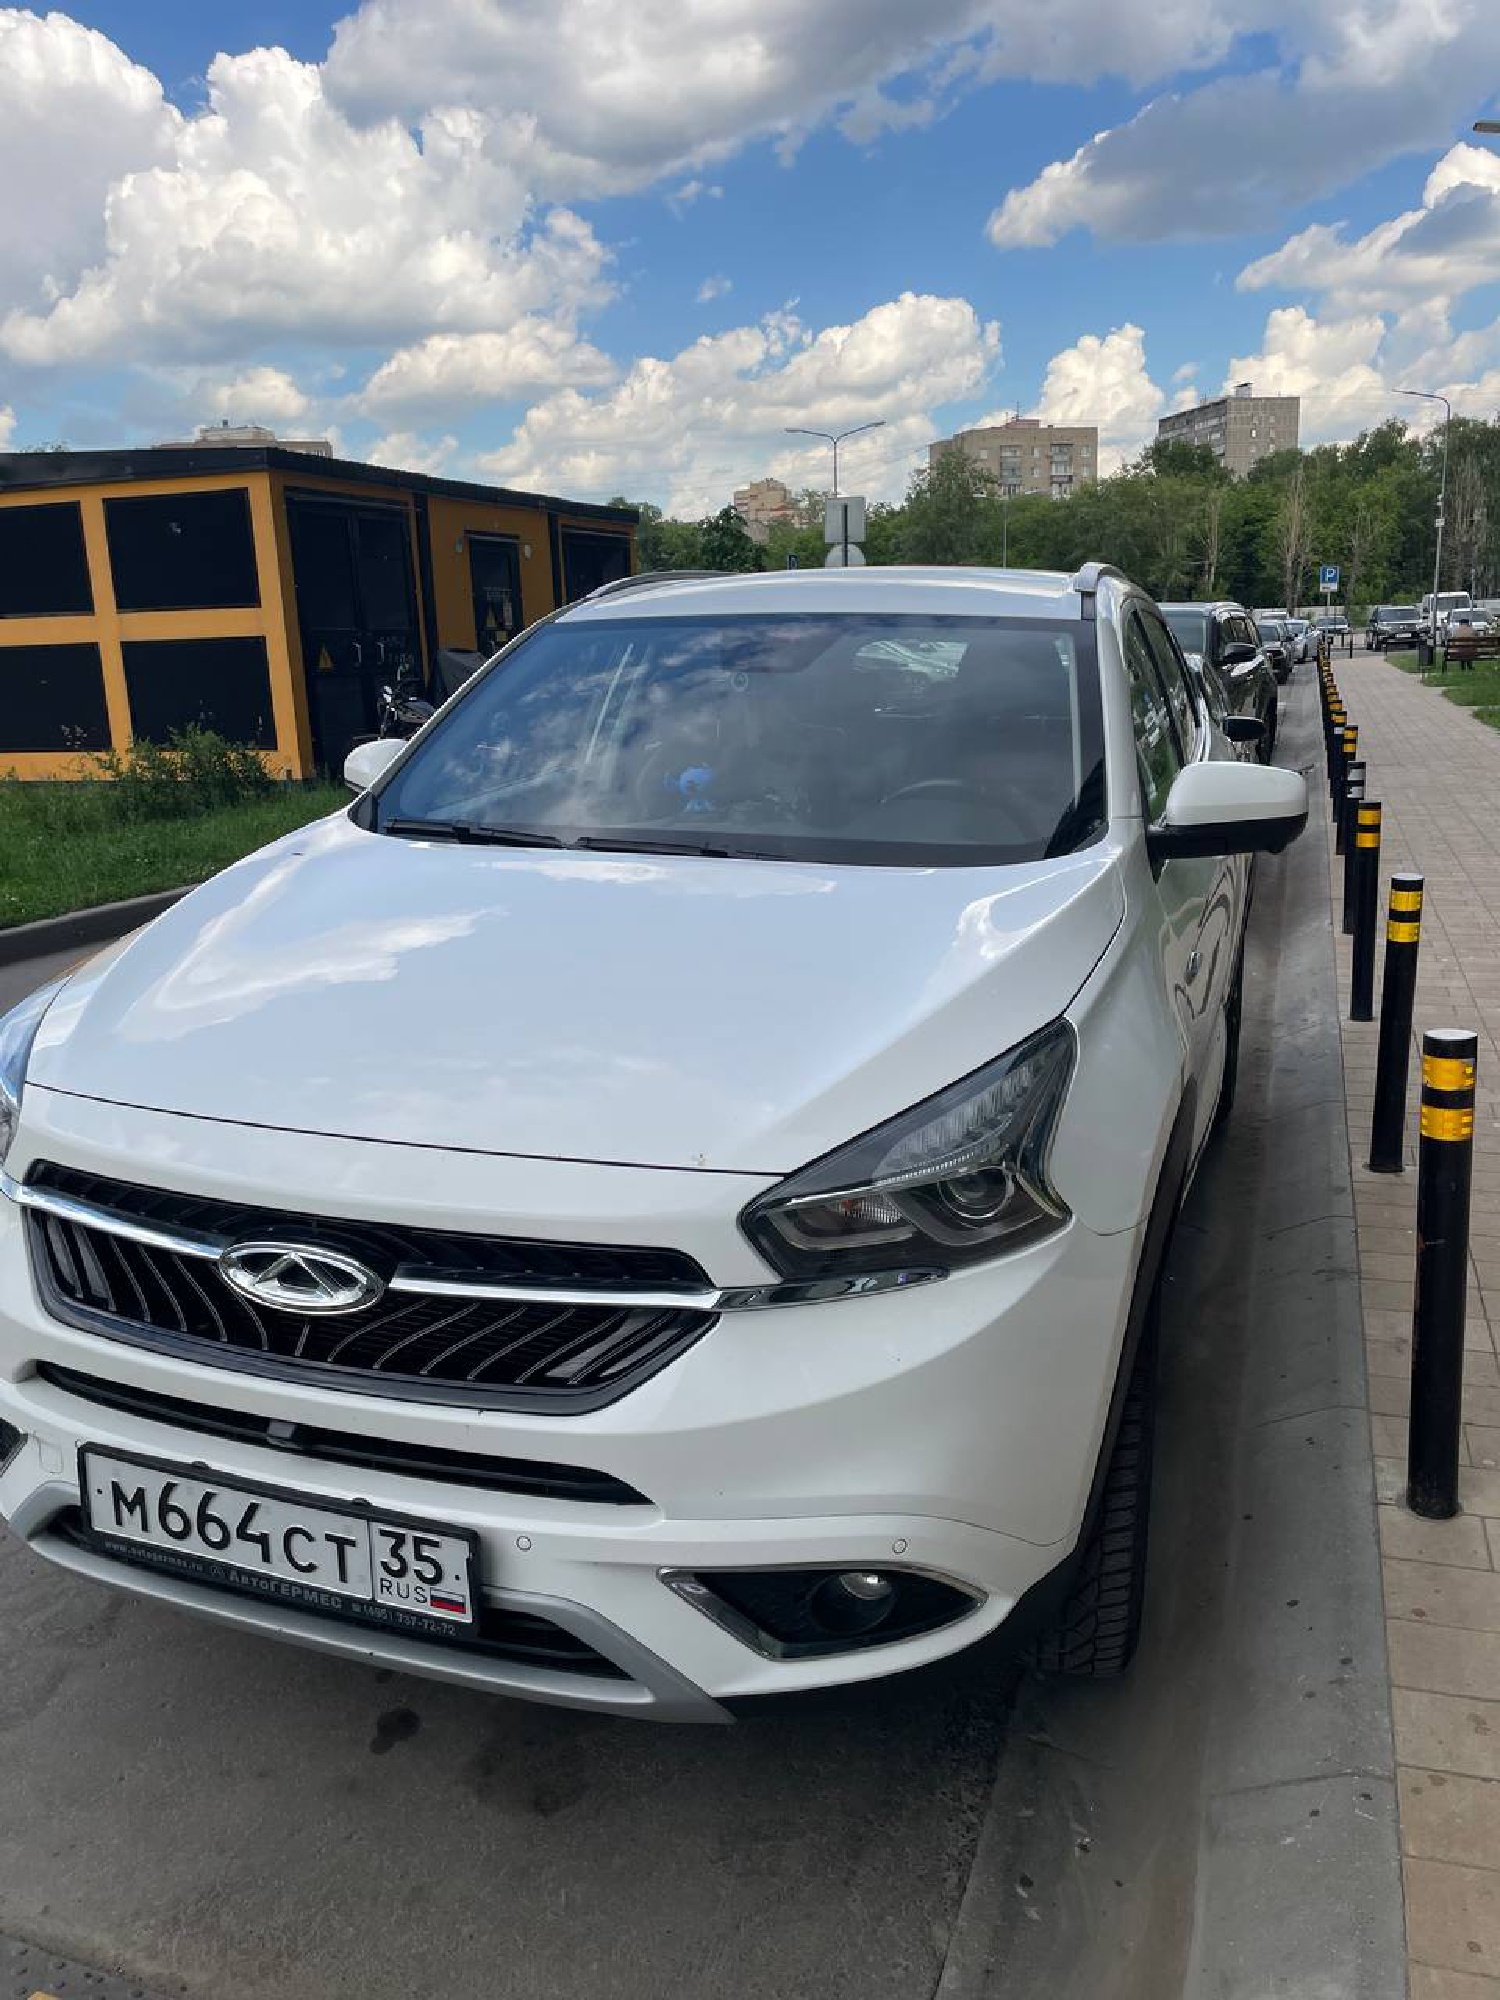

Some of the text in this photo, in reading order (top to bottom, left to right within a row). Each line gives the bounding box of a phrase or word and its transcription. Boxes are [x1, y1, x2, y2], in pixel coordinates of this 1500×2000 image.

[1325, 568, 1335, 582] P
[378, 1527, 444, 1586] 35
[379, 1578, 429, 1605] RUS
